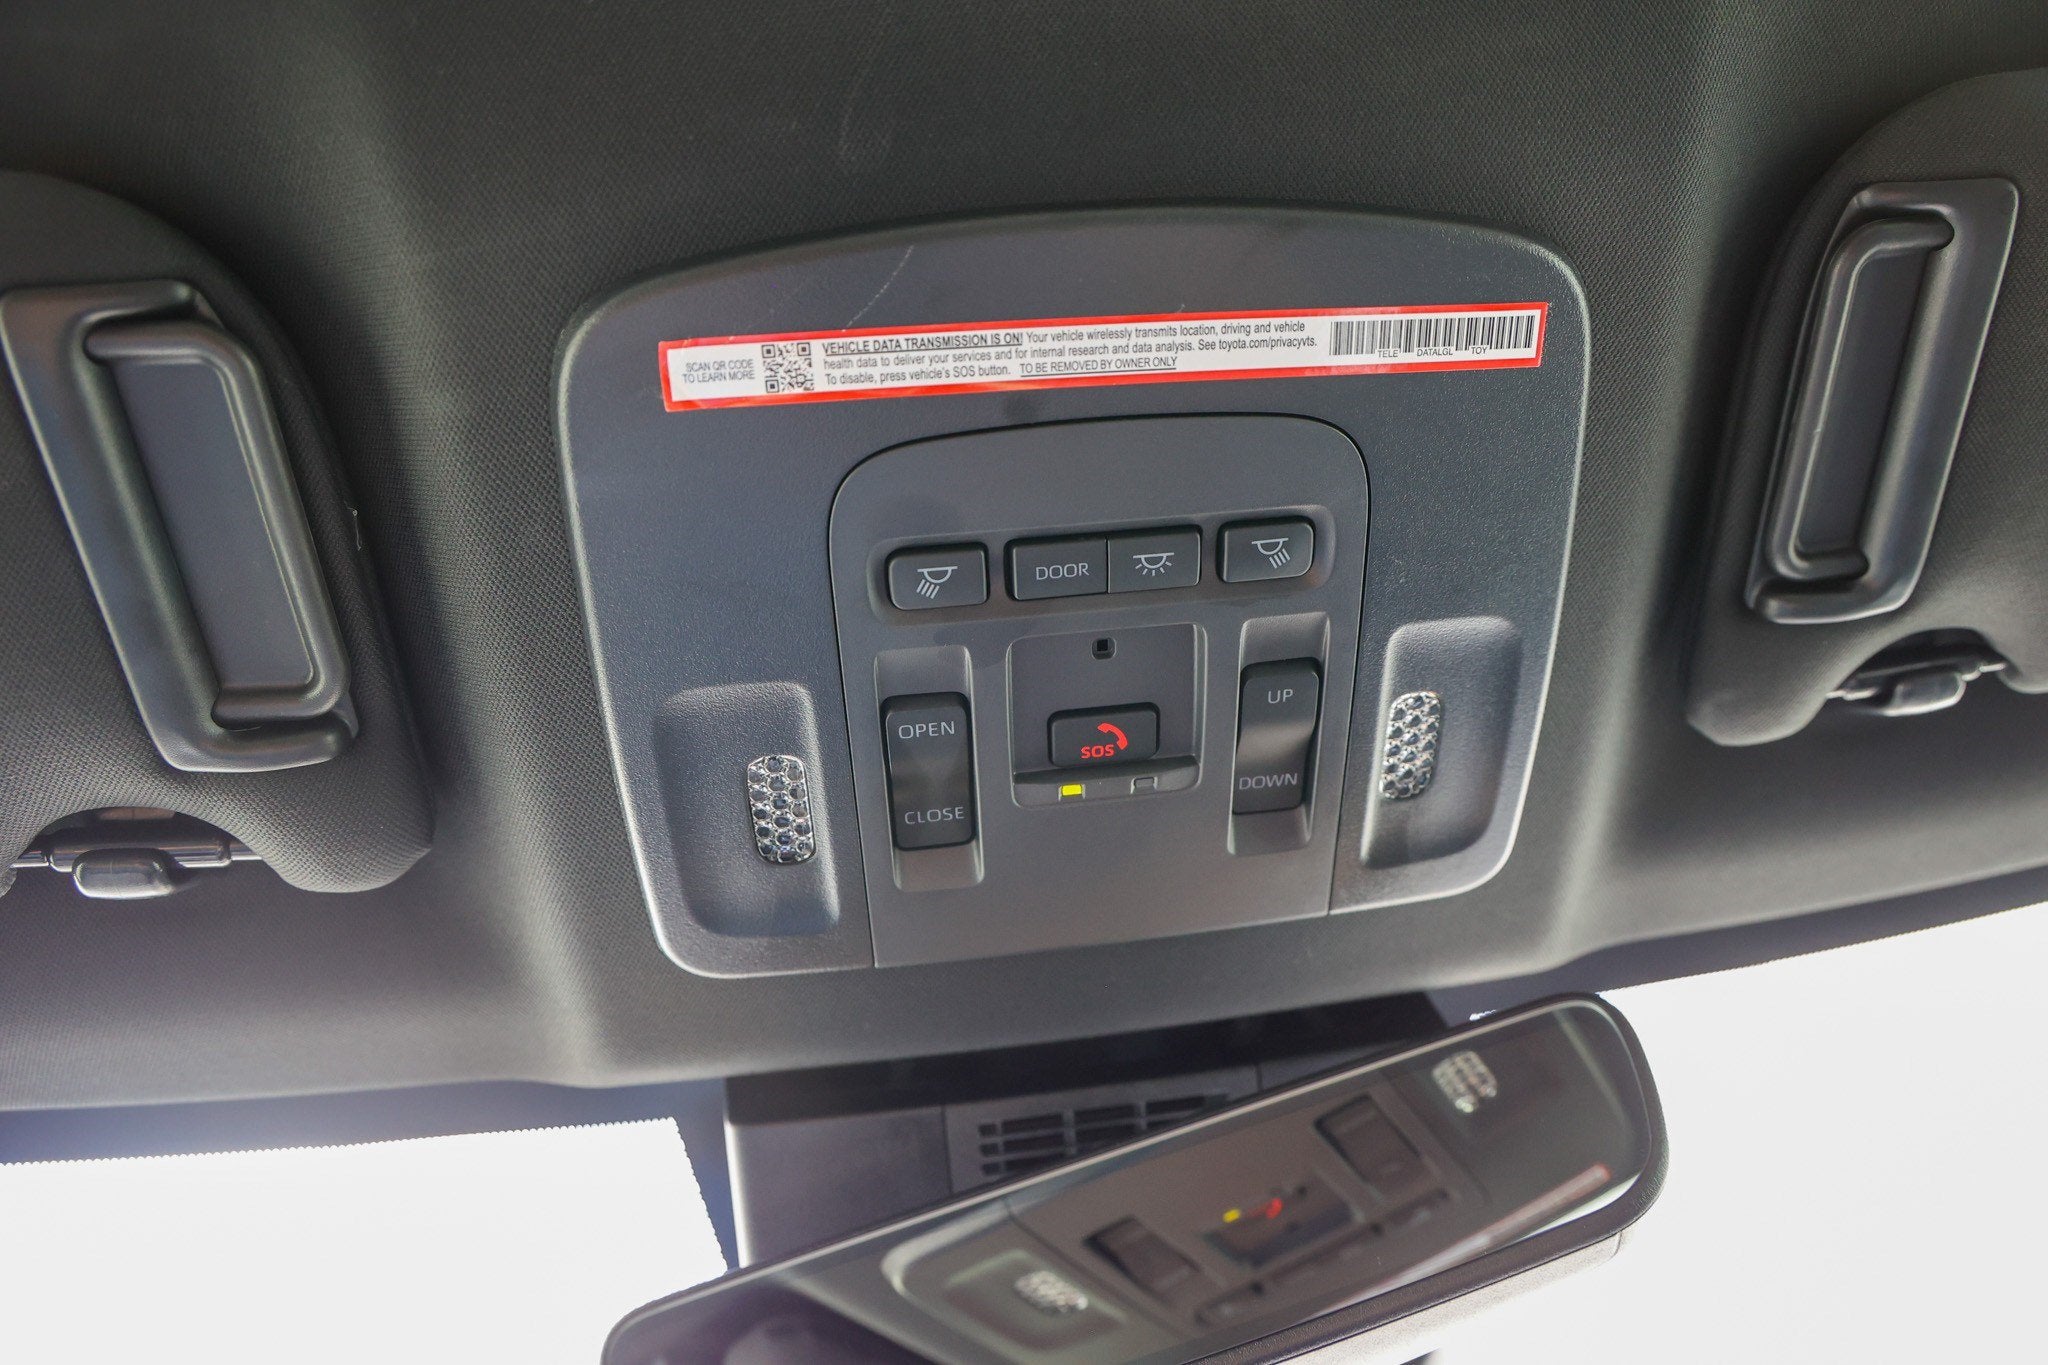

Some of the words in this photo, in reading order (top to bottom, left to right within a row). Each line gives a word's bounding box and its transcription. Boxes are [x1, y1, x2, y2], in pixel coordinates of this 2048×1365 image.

[822, 340, 870, 354] VEHICLE
[873, 338, 902, 351] DATA
[905, 334, 988, 349] TRANSMISSION
[990, 334, 1001, 345] IS
[1026, 331, 1048, 343] Your
[1051, 329, 1084, 342] vehicle
[1086, 327, 1132, 342] wirelessly
[1135, 326, 1178, 338] transmits
[1180, 324, 1218, 336] location,
[1221, 323, 1250, 336] driving
[1254, 322, 1271, 333] and
[1274, 321, 1305, 332] vehicle
[823, 357, 853, 370] health
[856, 356, 878, 368] data
[881, 356, 891, 367] to
[894, 354, 925, 366] deliver
[928, 355, 949, 367] your
[952, 350, 991, 363] services
[994, 348, 1012, 360] and
[1015, 348, 1027, 359] for
[1030, 346, 1066, 358] internal
[1068, 345, 1110, 356] research
[1112, 343, 1129, 354] and
[1132, 342, 1152, 353] data
[1155, 340, 1195, 354] analysis.
[1197, 338, 1216, 350] See
[1378, 349, 1398, 358] TELE
[1471, 346, 1487, 355] TOY
[686, 361, 711, 373] SCAN
[713, 360, 727, 372] QR
[730, 359, 754, 371] CODE
[1020, 363, 1033, 374] TO
[1036, 362, 1048, 373] BE
[1050, 359, 1099, 372] REMOVED
[1101, 358, 1113, 370] BY
[1115, 357, 1151, 369] OWNER
[1153, 356, 1178, 367] ONLY
[682, 373, 695, 384] TO
[697, 371, 727, 383] LEARN
[728, 370, 755, 382] MORE
[825, 373, 837, 385] To
[840, 371, 877, 385] disable,
[880, 371, 906, 385] press
[909, 366, 950, 380] vehicle's
[953, 365, 976, 378] SOS
[978, 364, 1011, 377] button.
[1035, 562, 1090, 581] DOOR
[1267, 688, 1294, 705] UP
[898, 720, 956, 740] OPEN
[1080, 744, 1115, 760] SOS
[1239, 773, 1298, 791] DOWN
[904, 806, 965, 825] CLOSE
